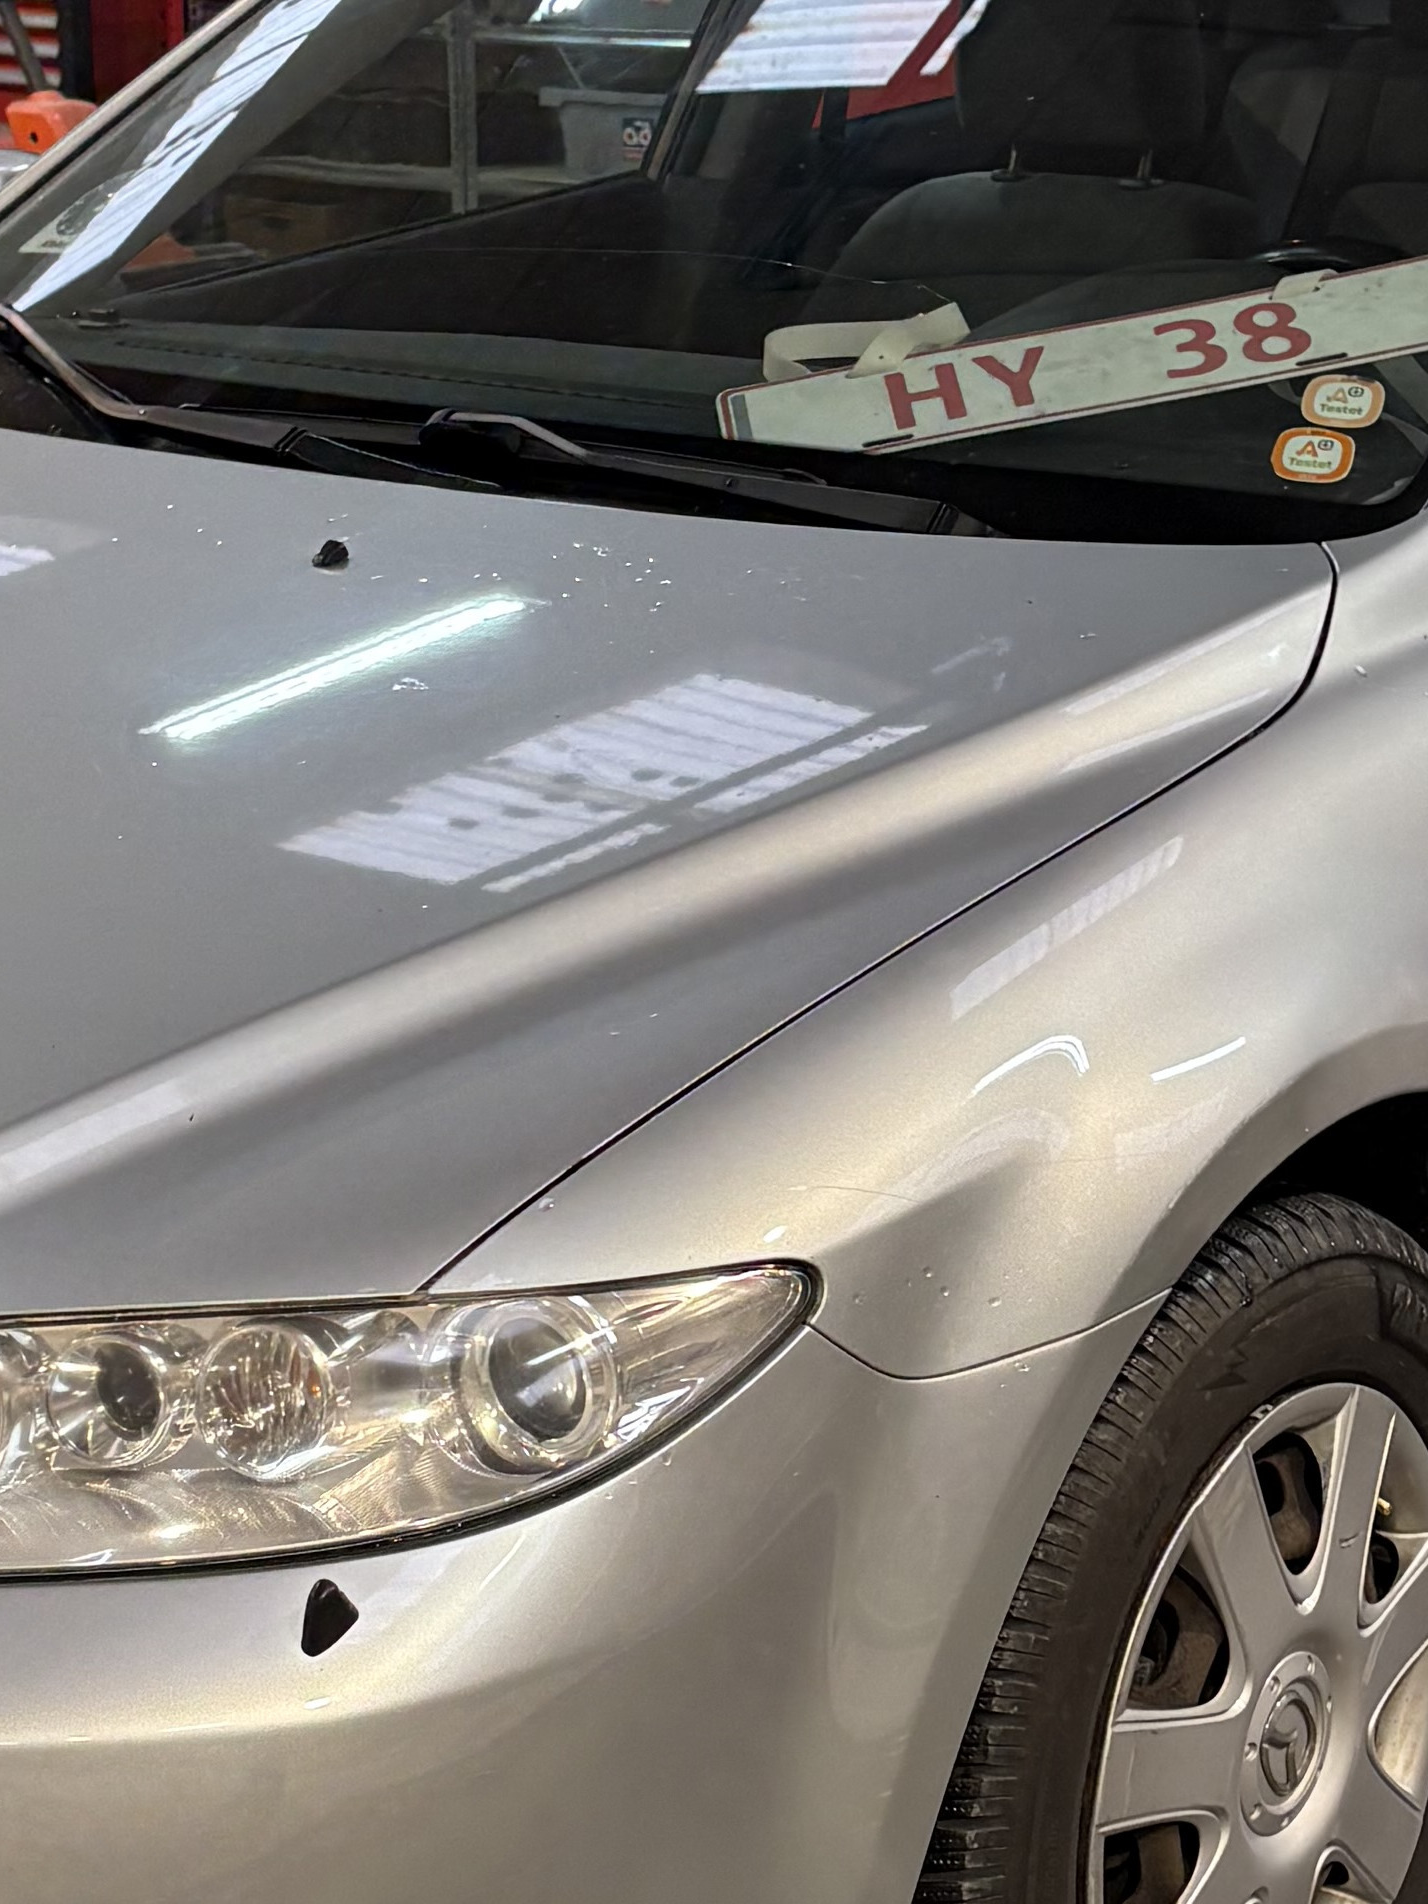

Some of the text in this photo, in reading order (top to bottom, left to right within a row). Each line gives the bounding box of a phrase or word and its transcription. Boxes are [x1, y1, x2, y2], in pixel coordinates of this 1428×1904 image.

[884, 302, 1312, 429] HY 38
[1320, 403, 1363, 415] Testet
[1288, 457, 1332, 469] Testet
